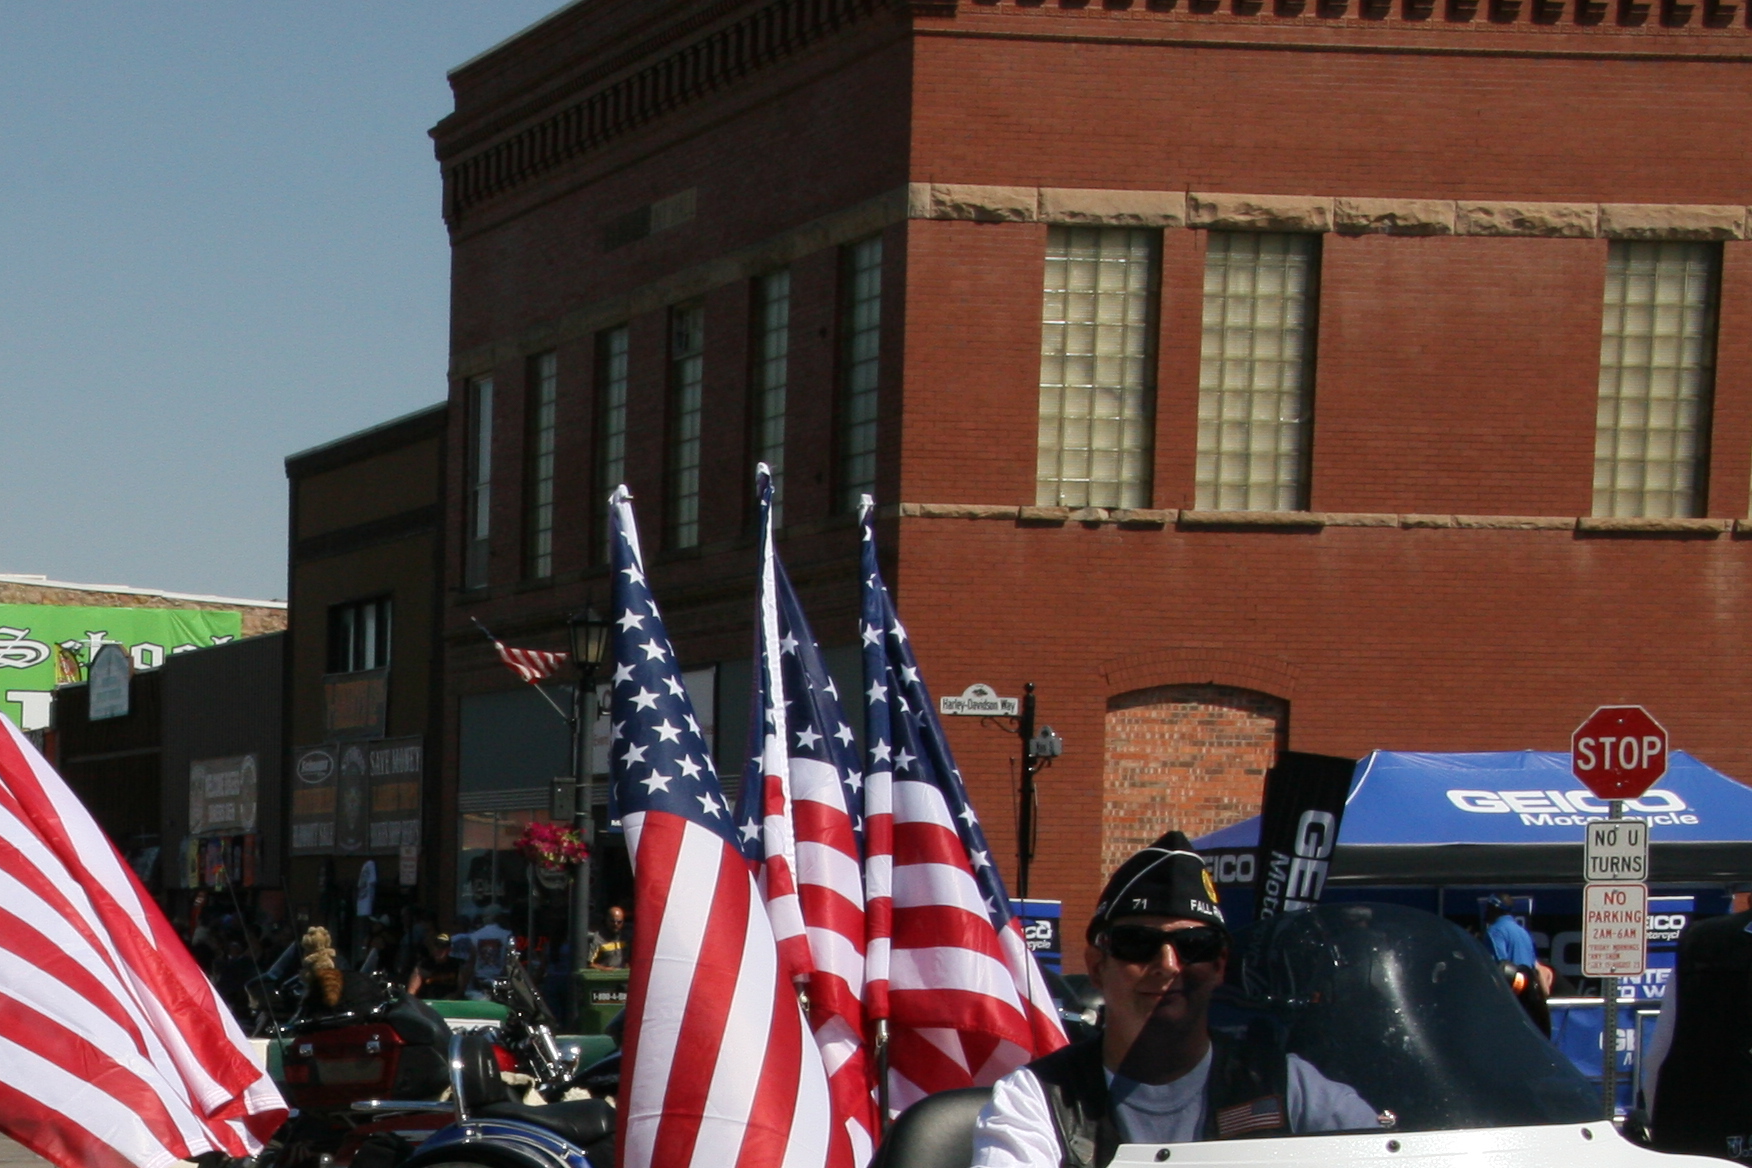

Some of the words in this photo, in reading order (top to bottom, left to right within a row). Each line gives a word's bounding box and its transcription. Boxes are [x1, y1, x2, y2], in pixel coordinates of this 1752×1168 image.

[942, 698, 999, 713] Harley-Davidson
[1000, 700, 1016, 713] Way
[1576, 736, 1662, 771] STOP
[1594, 829, 1616, 846] NO
[1627, 829, 1639, 846] U
[1590, 855, 1642, 873] TURNS
[1603, 890, 1627, 906] NO
[1132, 899, 1148, 910] 71
[1190, 899, 1213, 915] FALL
[1588, 910, 1643, 923] PARKING
[1593, 929, 1637, 939] 2AM-6AM
